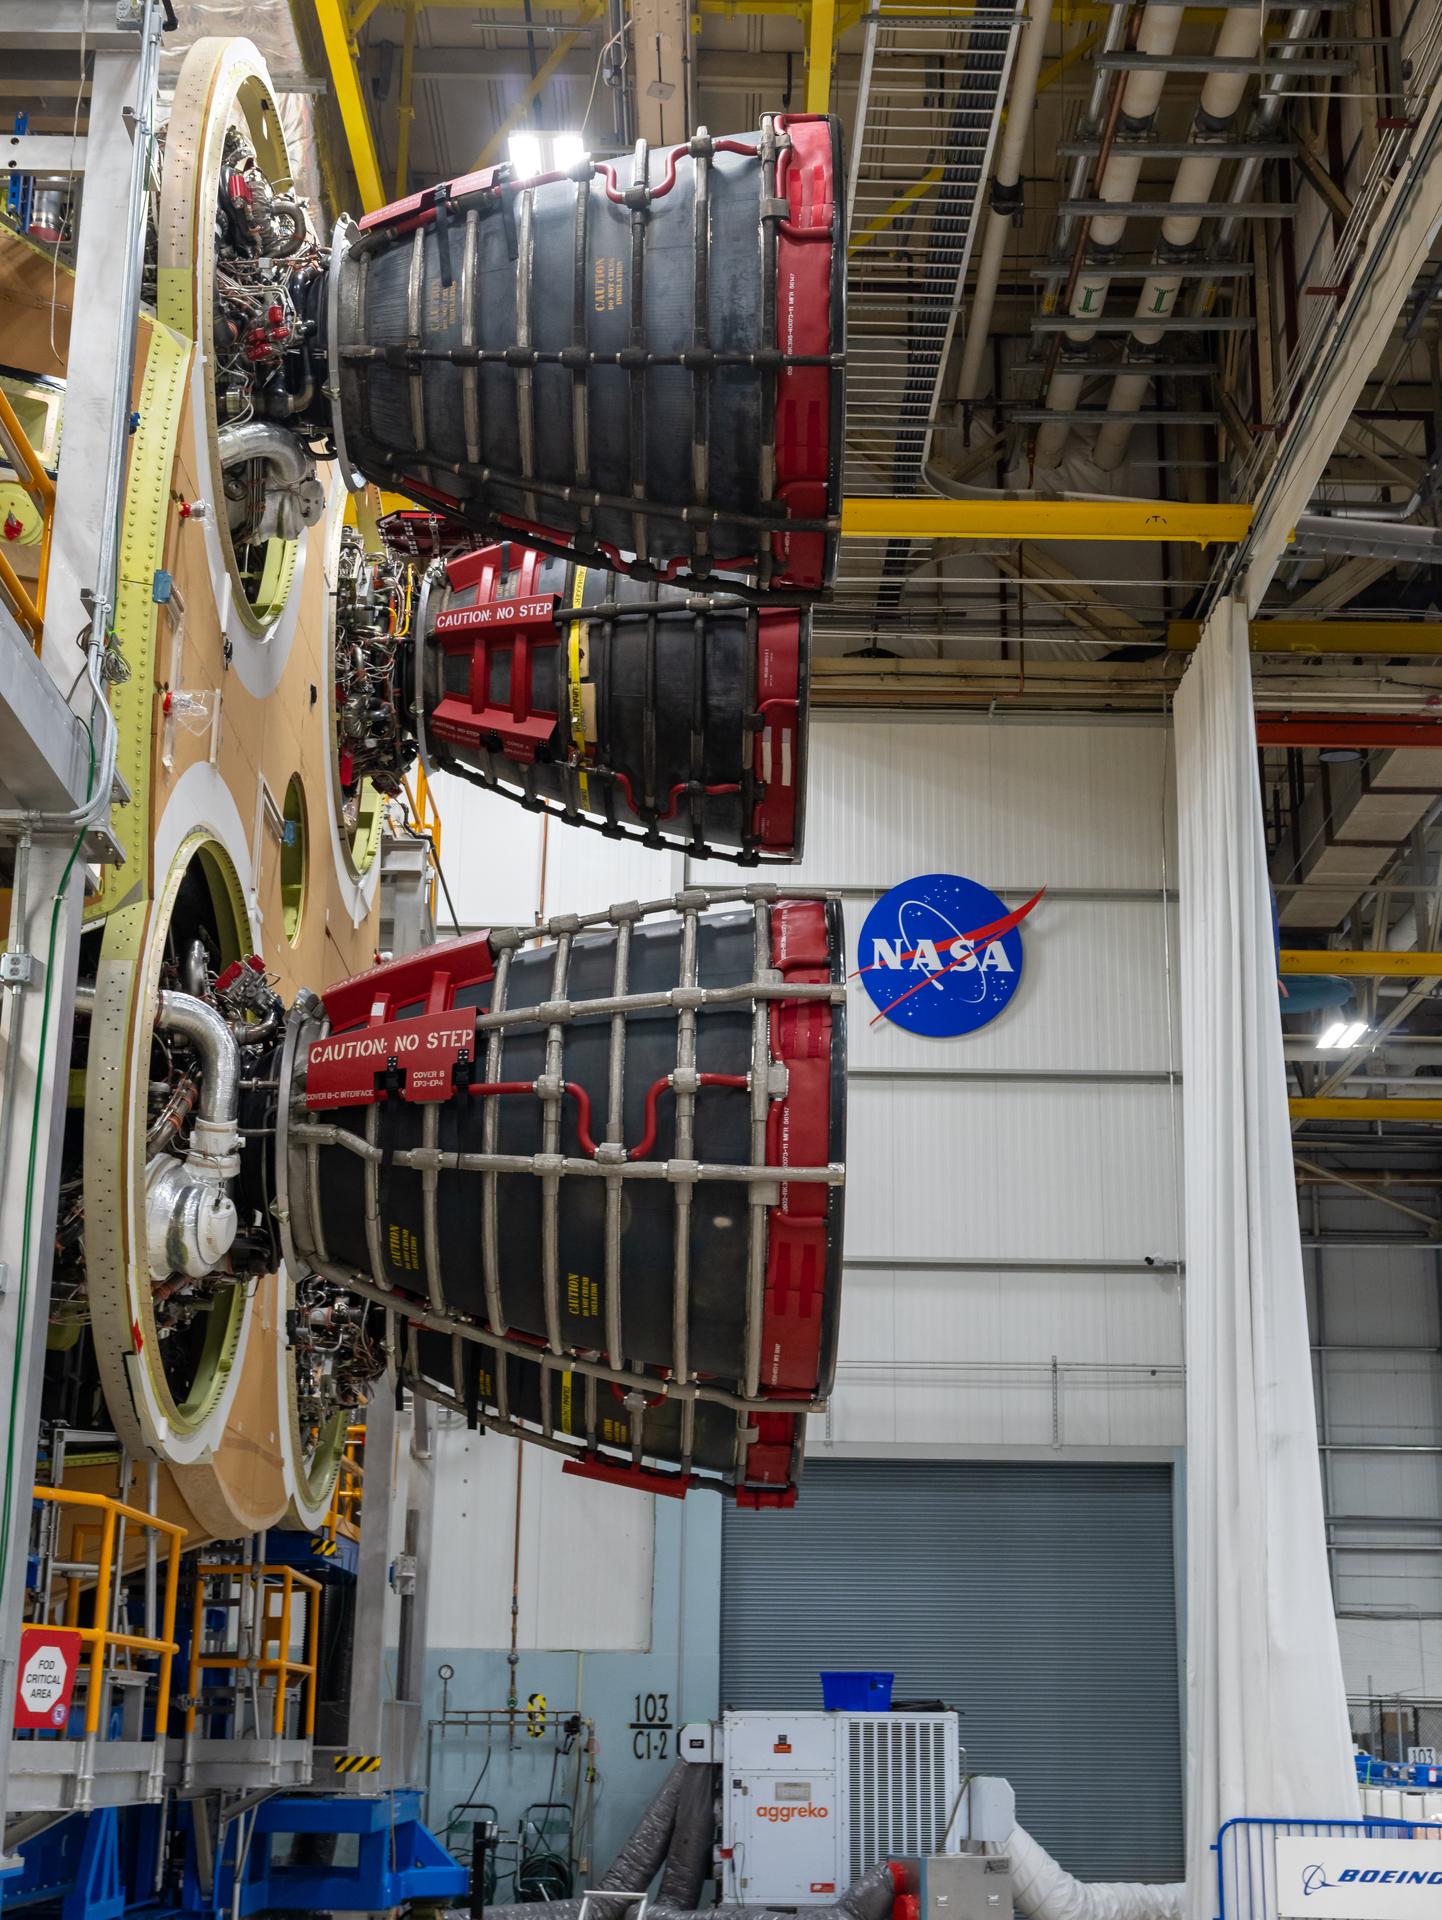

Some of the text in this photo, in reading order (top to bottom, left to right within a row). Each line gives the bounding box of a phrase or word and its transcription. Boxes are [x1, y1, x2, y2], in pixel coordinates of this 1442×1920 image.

[594, 256, 605, 312] CAUTION
[607, 283, 615, 298] NOT
[607, 300, 615, 311] DO
[437, 603, 552, 628] CAUTION: NO STEP
[872, 938, 1014, 972] NASA
[310, 1029, 474, 1064] CAUTION: NO STEP
[413, 1070, 437, 1079] COVER
[306, 1091, 326, 1101] COVER
[340, 1088, 375, 1099] INTERFACE
[389, 1223, 402, 1267] CAUTION
[568, 1272, 579, 1315] CAUTION
[39, 1660, 55, 1670] FOD
[26, 1673, 61, 1685] CRITICAL
[30, 1688, 52, 1699] AREA
[635, 1693, 669, 1722] 103
[633, 1730, 668, 1760] C1-2
[1412, 1748, 1433, 1765] 103
[756, 1801, 828, 1823] aggreko
[1338, 1869, 1442, 1885] BOEING
